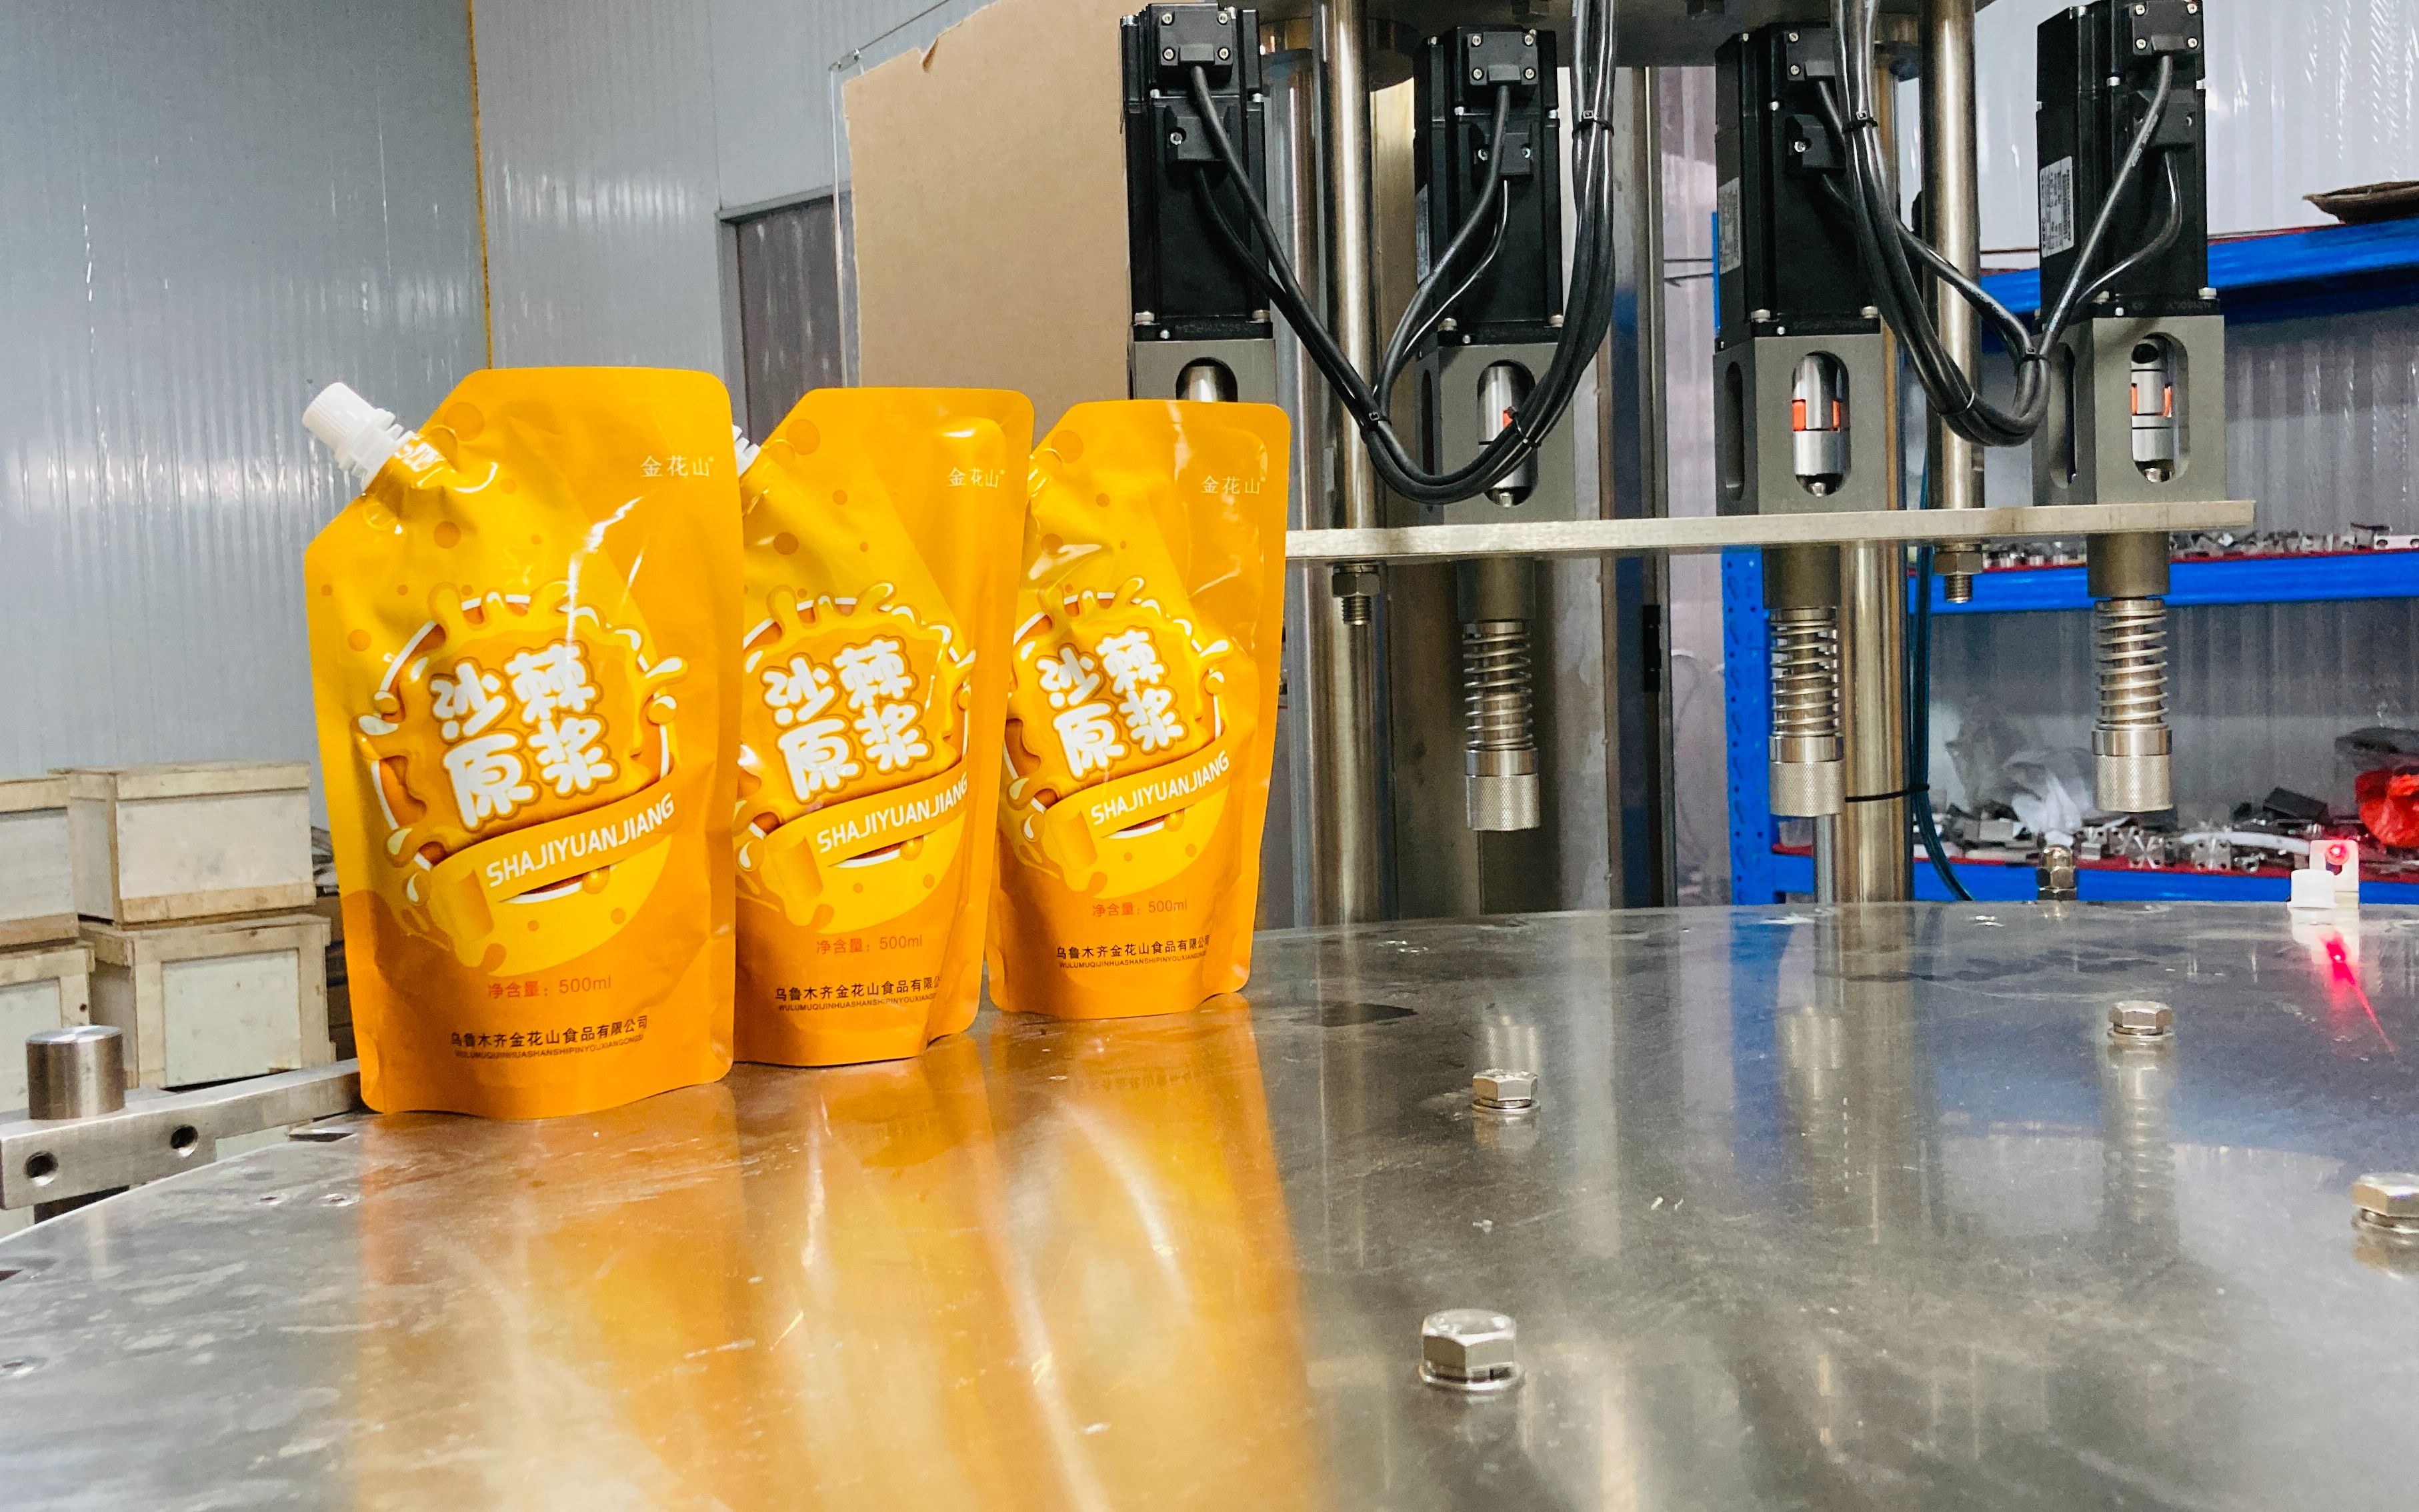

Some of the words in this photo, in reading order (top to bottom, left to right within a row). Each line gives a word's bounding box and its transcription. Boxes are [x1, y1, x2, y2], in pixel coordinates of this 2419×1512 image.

[640, 455, 709, 477] 金花山
[947, 467, 999, 489] 金花山
[1201, 475, 1260, 495] 金花山
[429, 643, 597, 741] 沙棘
[761, 638, 913, 725] 沙棘
[1036, 629, 1164, 708] 沙棘
[777, 703, 928, 801] 原浆
[1053, 687, 1185, 777] 原浆
[443, 717, 613, 827] 原浆
[1090, 749, 1230, 827] SHAJIYUANJIANG
[485, 792, 675, 888] SHAJIYUANJIANG
[816, 771, 968, 853] SHAJIYUANJIANG
[879, 934, 923, 950] 500ml
[1148, 898, 1187, 913] 500ml
[558, 975, 612, 994] 500ml
[451, 1015, 648, 1049] 乌鲁木齐金花山食品有限公司
